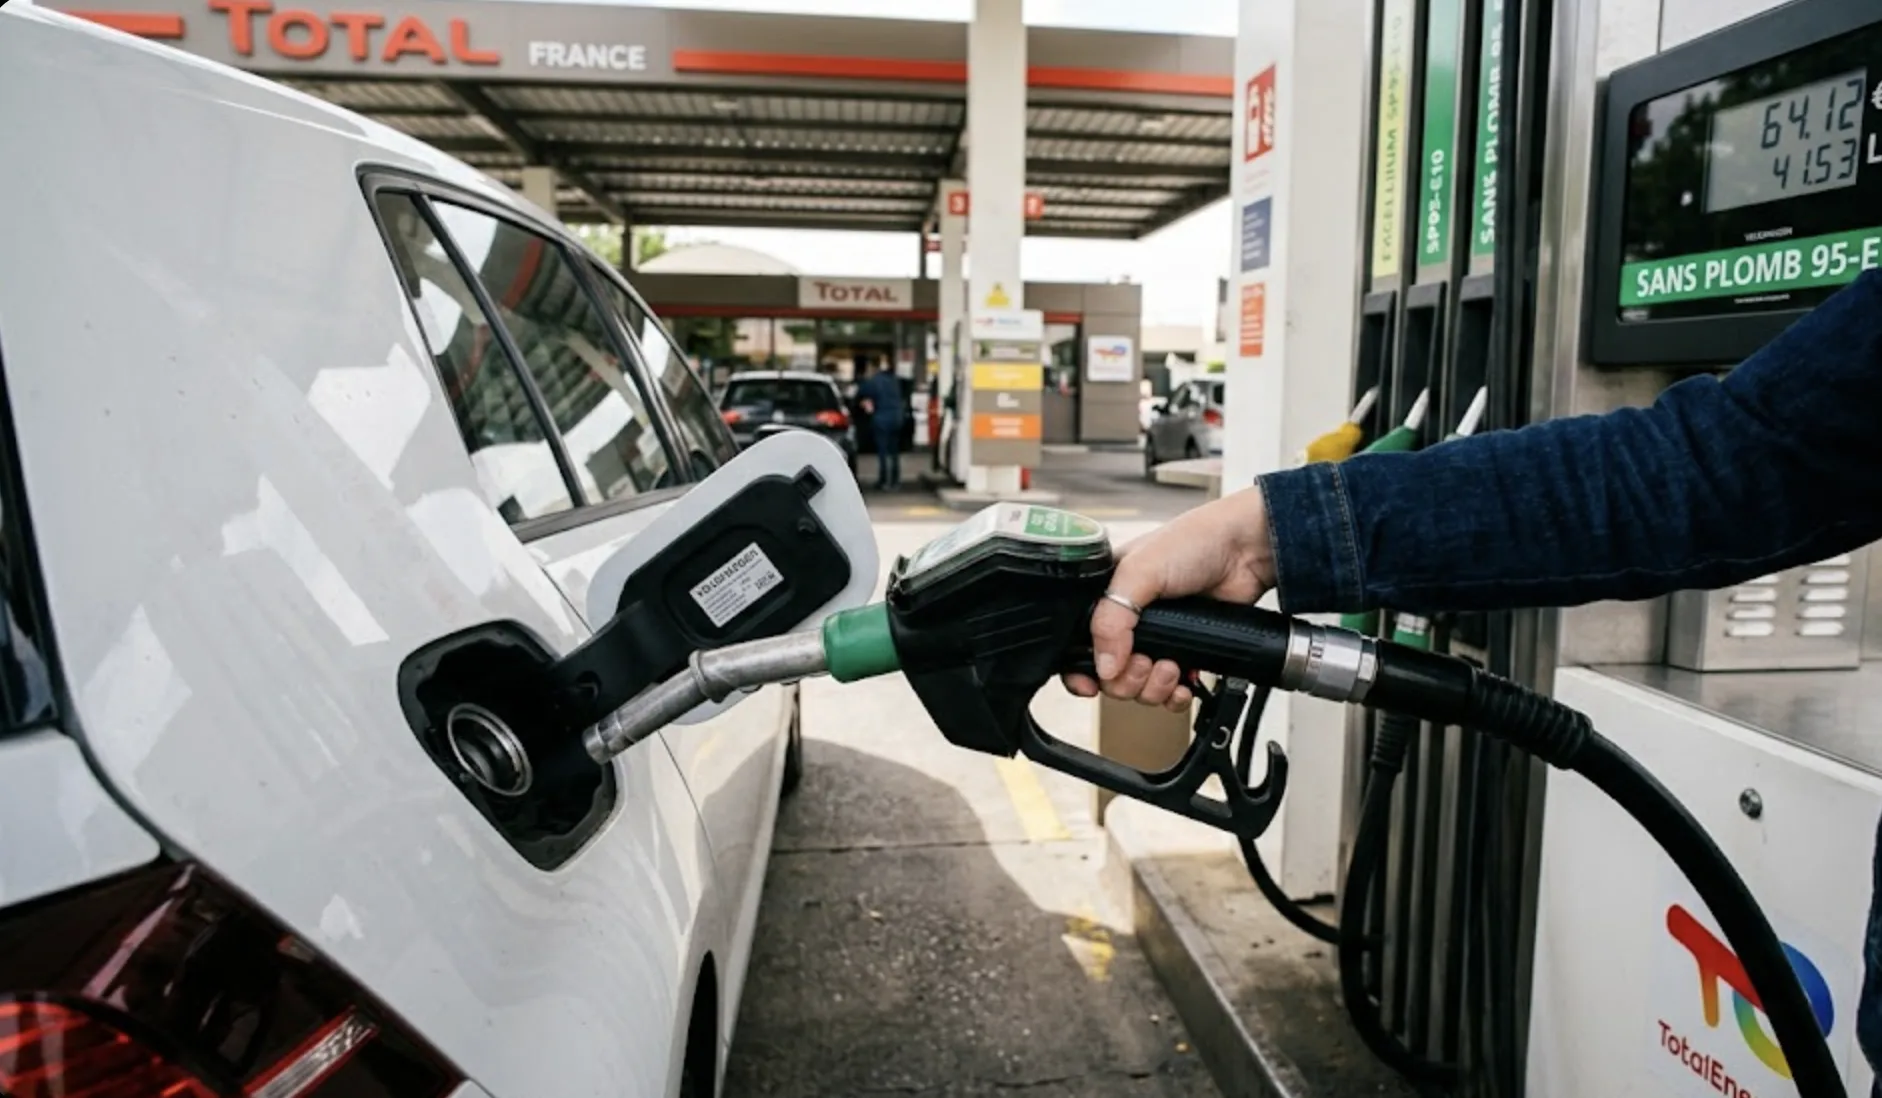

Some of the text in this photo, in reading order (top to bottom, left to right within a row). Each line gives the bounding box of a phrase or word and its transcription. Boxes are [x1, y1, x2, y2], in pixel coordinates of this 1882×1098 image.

[208, 0, 646, 70] TOTAL FRANCE
[1761, 78, 1864, 149] 64.12
[1773, 138, 1857, 189] 41.53
[813, 281, 899, 303] TOTAL
[1637, 262, 1697, 298] SANS
[1704, 248, 1802, 290] PLOMB
